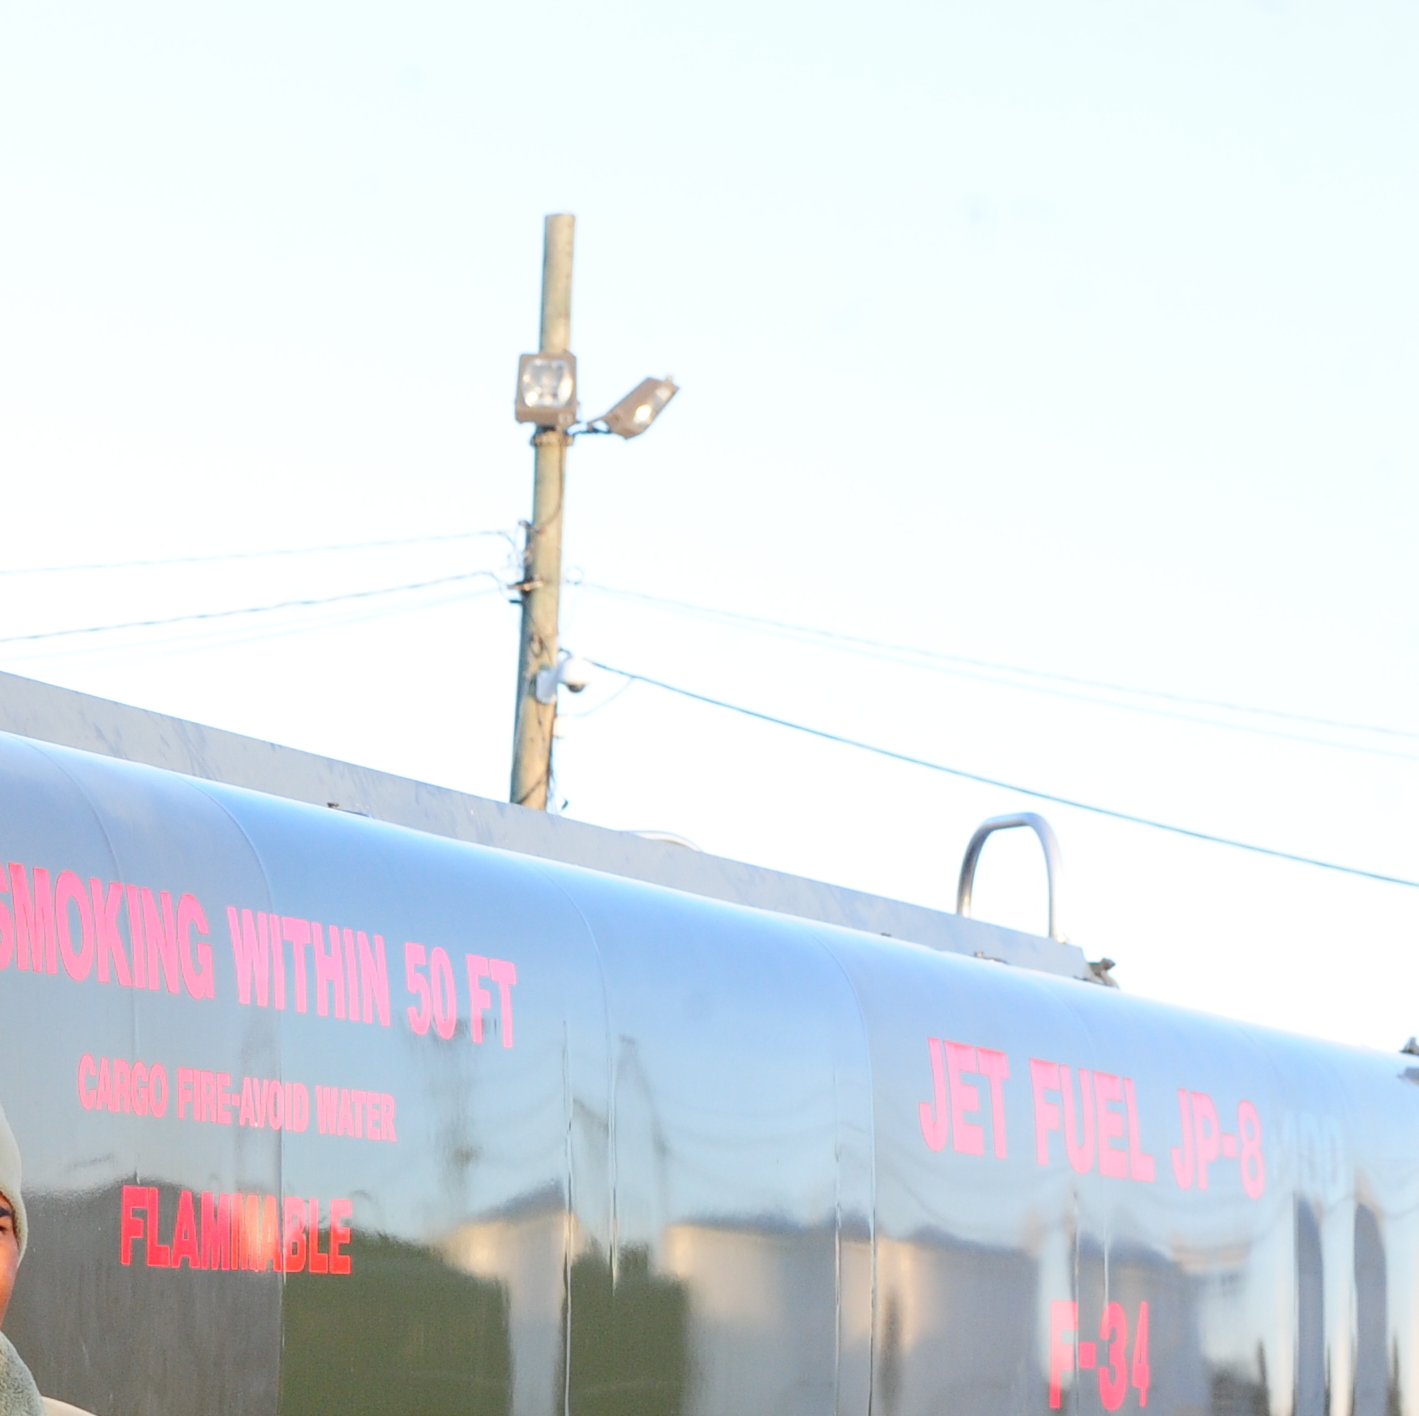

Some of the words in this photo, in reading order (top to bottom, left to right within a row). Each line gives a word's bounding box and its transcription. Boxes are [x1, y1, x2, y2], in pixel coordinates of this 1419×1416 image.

[226, 905, 390, 1027] WITHIN
[406, 941, 458, 1041] 50
[465, 953, 519, 1050] FT
[77, 1051, 167, 1117] CARGO
[176, 1065, 310, 1133] FIRE-AVOID
[314, 1083, 397, 1143] WATER
[918, 1036, 1010, 1160] JET
[1029, 1057, 1156, 1183] FUEL
[1170, 1087, 1265, 1200] JP-8
[120, 1184, 353, 1275] FLAMMABLE
[1049, 1300, 1151, 1411] F-34
